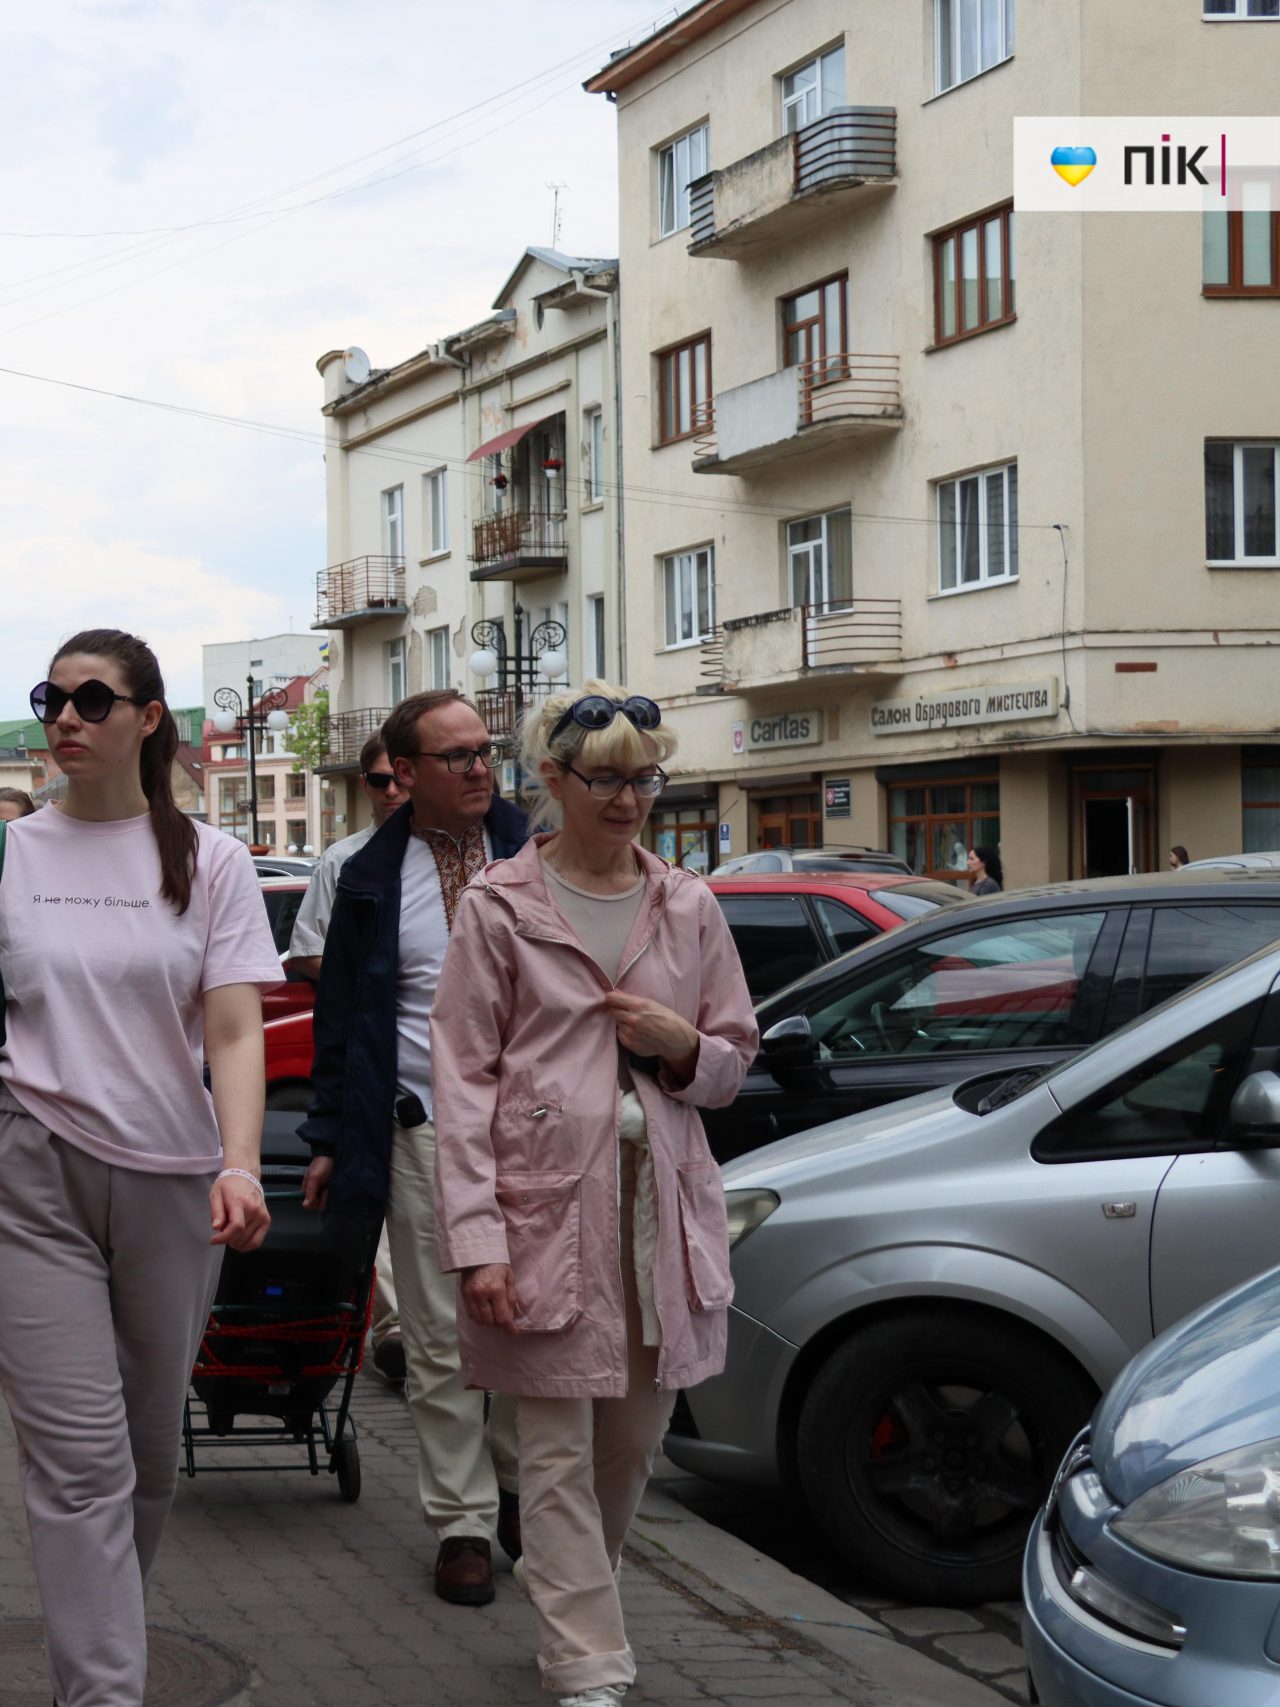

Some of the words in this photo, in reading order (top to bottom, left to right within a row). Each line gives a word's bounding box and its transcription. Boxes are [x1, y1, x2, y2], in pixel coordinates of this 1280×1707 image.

[750, 713, 810, 743] Caritas
[871, 706, 911, 727] Салон
[915, 698, 980, 729] Обрядового
[32, 894, 41, 904] Я
[64, 896, 101, 909] можу
[104, 896, 153, 908] більше.
